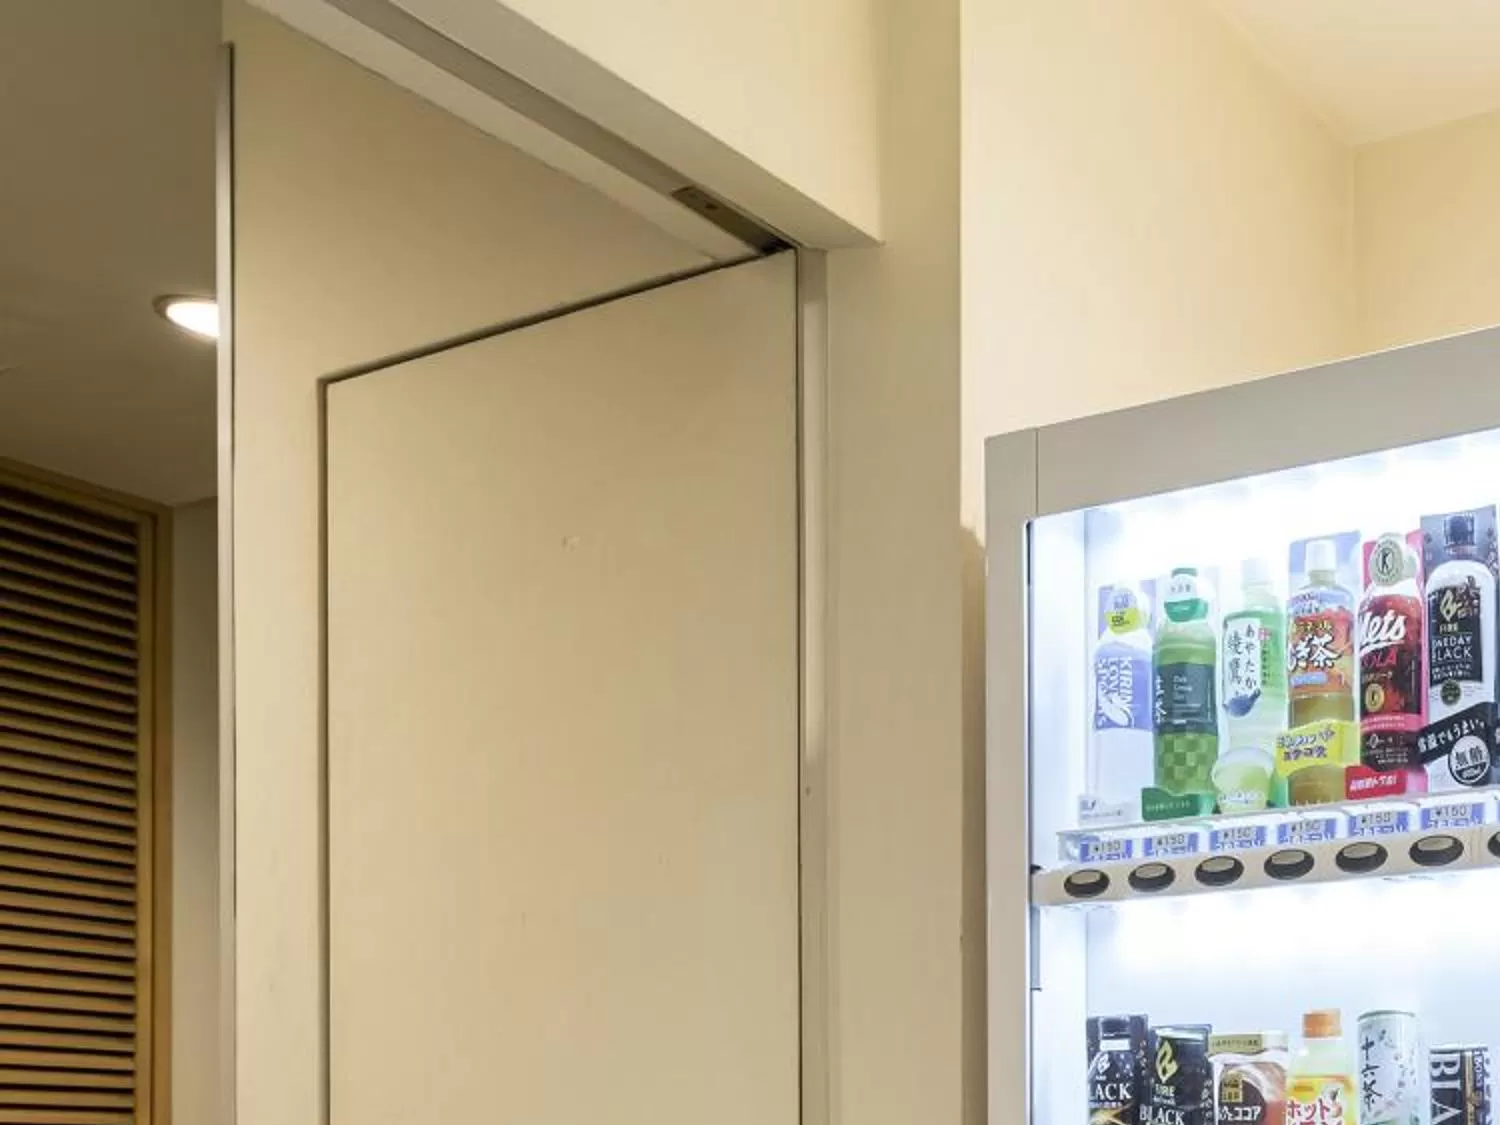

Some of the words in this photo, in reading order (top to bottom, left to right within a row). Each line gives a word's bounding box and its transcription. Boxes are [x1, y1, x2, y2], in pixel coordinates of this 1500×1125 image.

[1360, 1036, 1383, 1112] 十六茶
[1090, 1083, 1133, 1101] ACK
[1287, 1098, 1331, 1121] ホット
